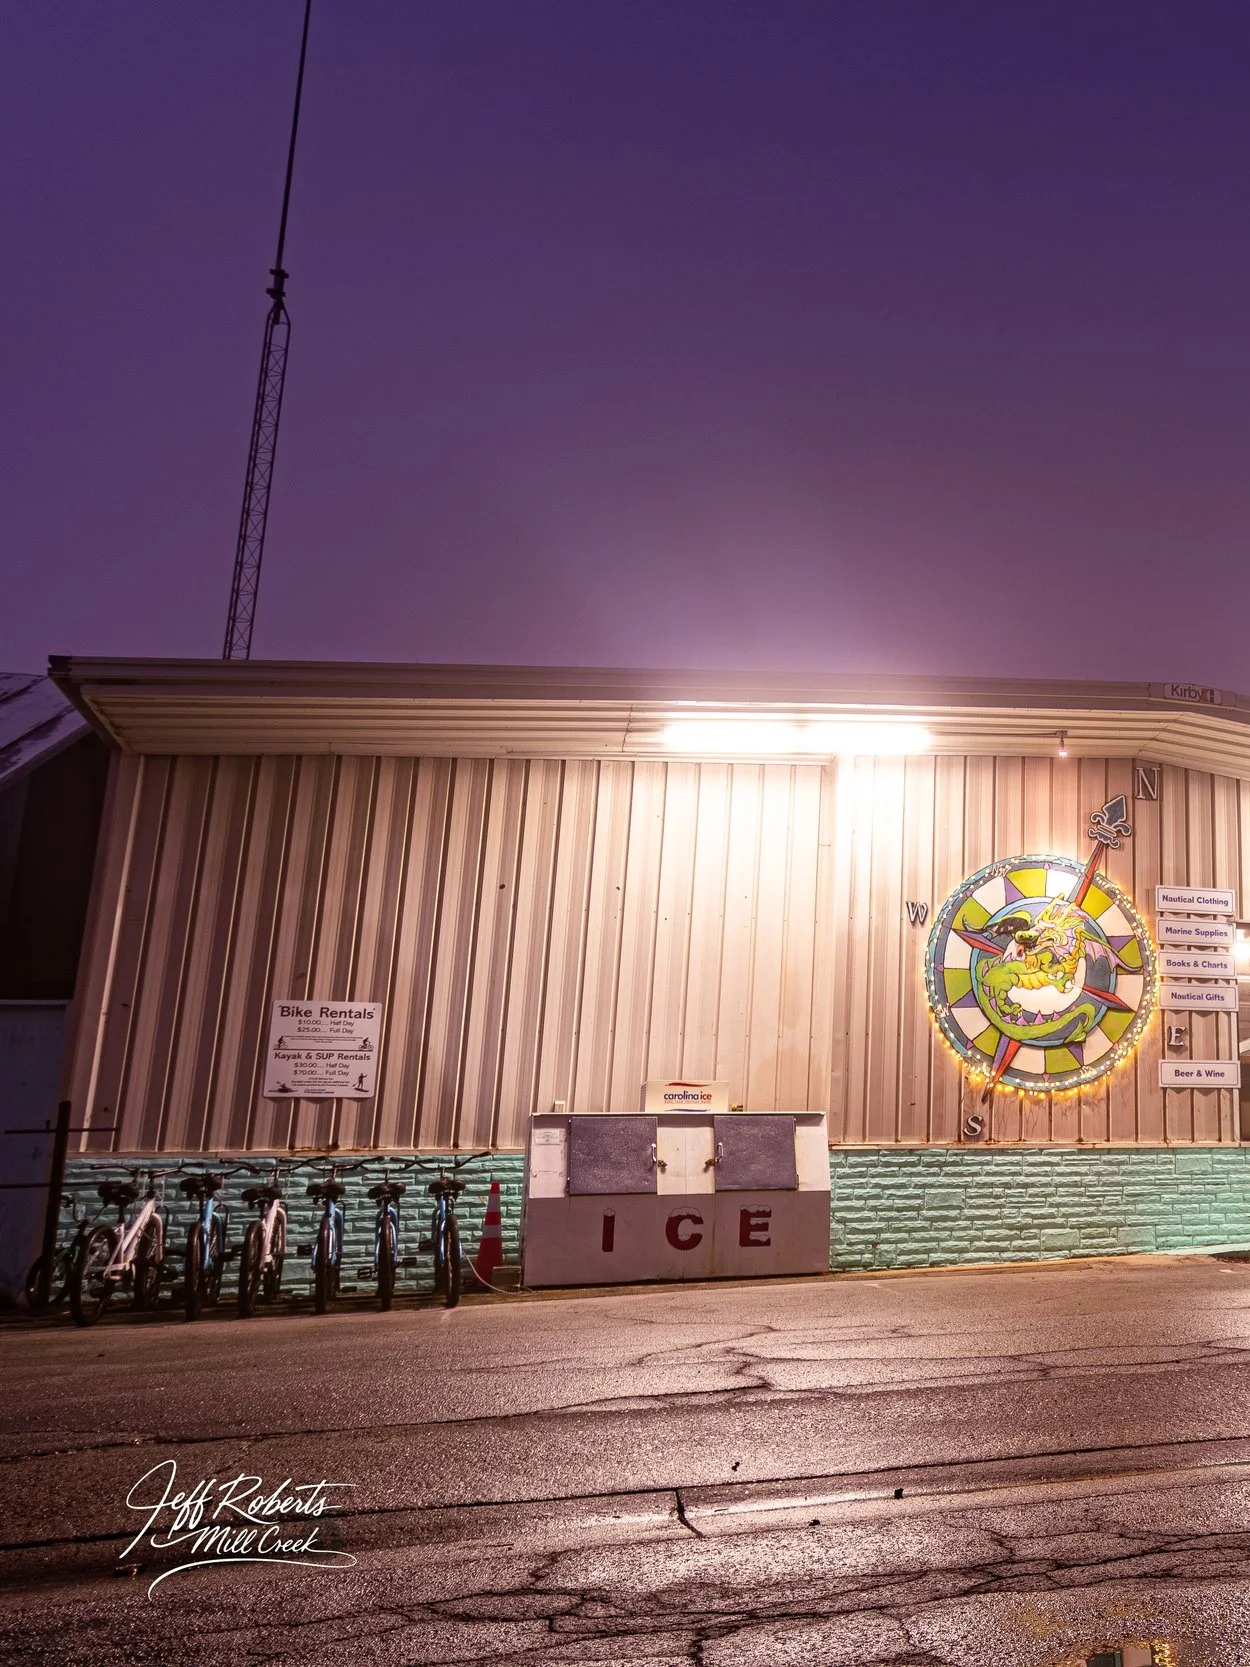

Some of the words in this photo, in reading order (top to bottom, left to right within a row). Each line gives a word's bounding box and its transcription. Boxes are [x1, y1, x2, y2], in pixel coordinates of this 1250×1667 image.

[1136, 767, 1161, 800] N
[1162, 894, 1195, 904] Nautical
[1196, 896, 1229, 907] Clothing
[905, 901, 929, 924] W
[1165, 926, 1193, 936] Marine
[1195, 928, 1228, 938] Supplies
[1166, 959, 1191, 968] Books
[1193, 960, 1200, 968] &
[1201, 960, 1228, 969] Charts
[1171, 992, 1204, 1001] Nautical
[1205, 993, 1225, 1002] Gifts
[280, 1005, 313, 1018] Bike
[319, 1007, 374, 1020] Rentals
[1168, 1025, 1186, 1047] E
[274, 1051, 302, 1061] Kayak
[305, 1052, 313, 1060] &
[315, 1052, 335, 1060] SUP
[337, 1052, 371, 1061] Rentals
[1174, 1069, 1194, 1078] Beer
[1196, 1069, 1203, 1078] &
[1204, 1069, 1225, 1078] Wine
[663, 1090, 699, 1101] carolina
[700, 1091, 713, 1101] ice
[963, 1113, 984, 1137] S
[602, 1204, 772, 1252] ICE
